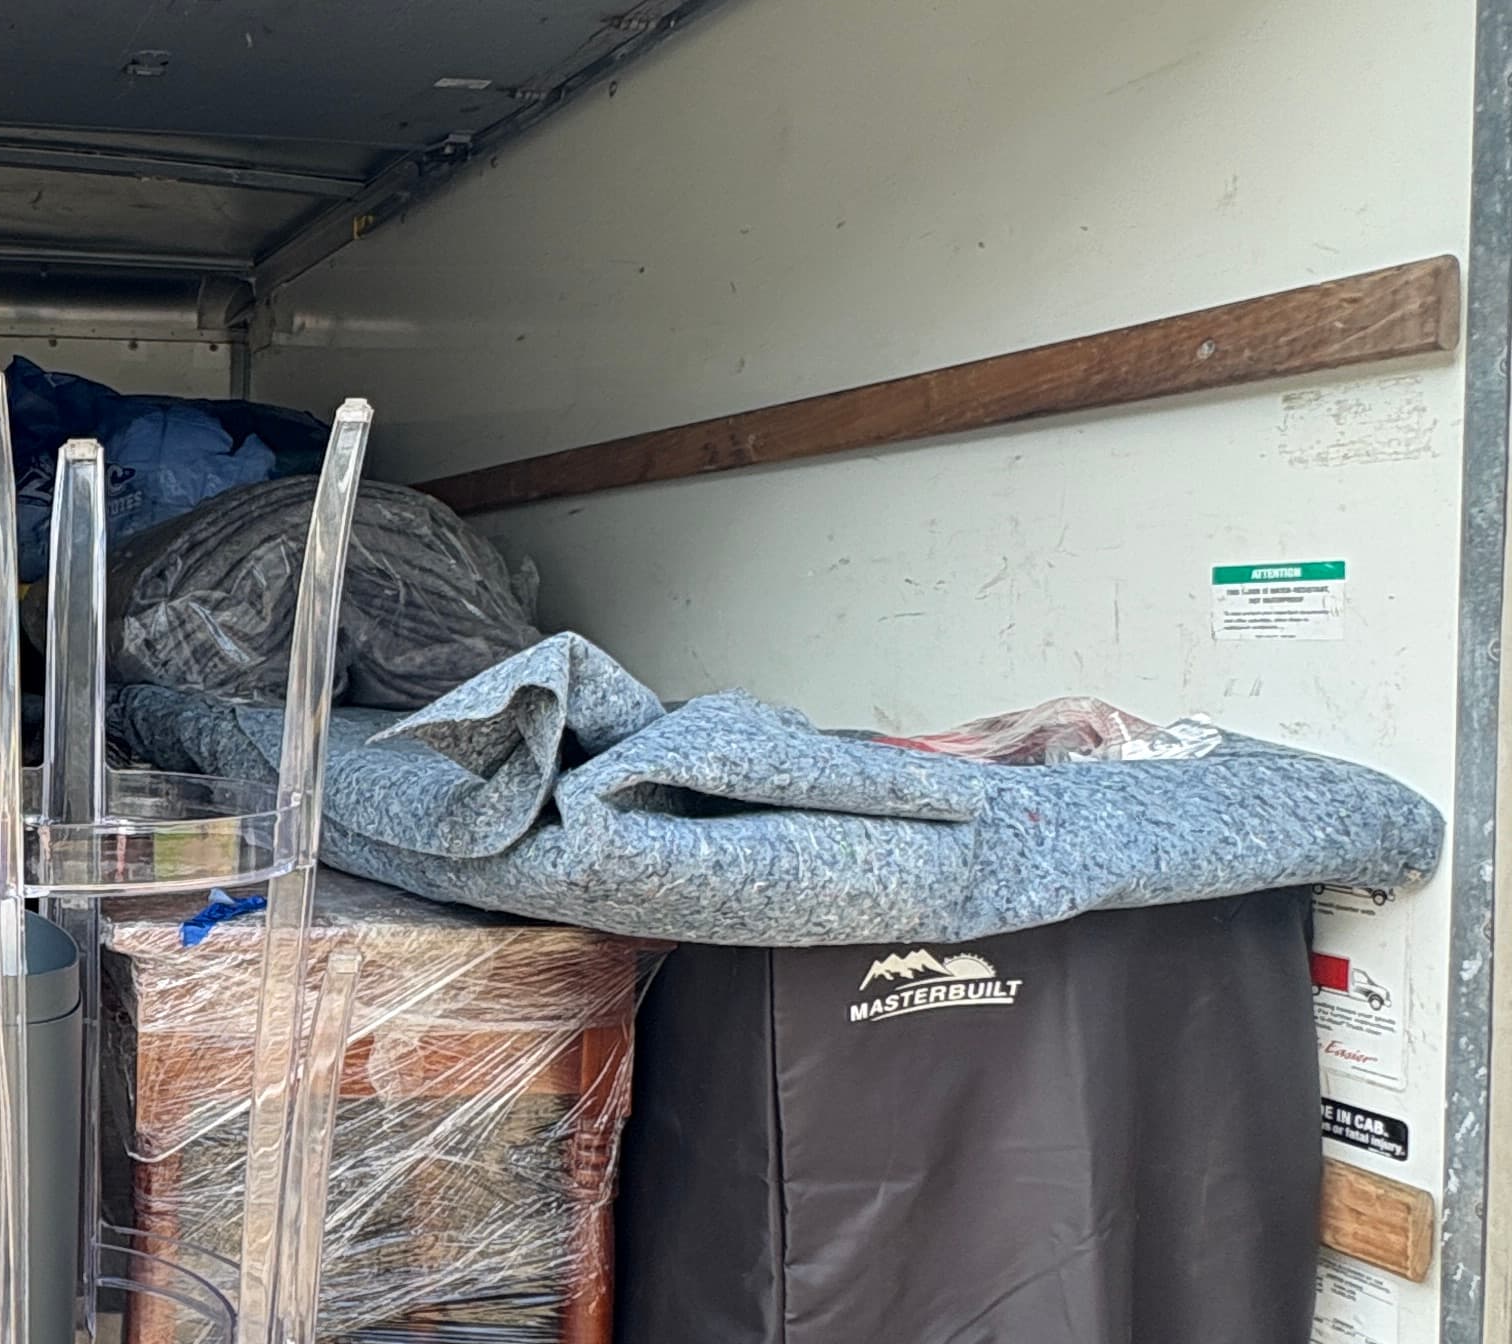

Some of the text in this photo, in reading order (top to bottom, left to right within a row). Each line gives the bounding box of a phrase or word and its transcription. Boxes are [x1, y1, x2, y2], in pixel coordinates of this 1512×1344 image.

[849, 980, 1024, 1022] MASTERBUILT
[1324, 1039, 1378, 1064] Easier
[1336, 1108, 1351, 1125] IN
[1354, 1114, 1390, 1138] CAB.
[1332, 1124, 1344, 1135] or
[1345, 1127, 1369, 1145] fatal
[1370, 1134, 1406, 1156] injury.
